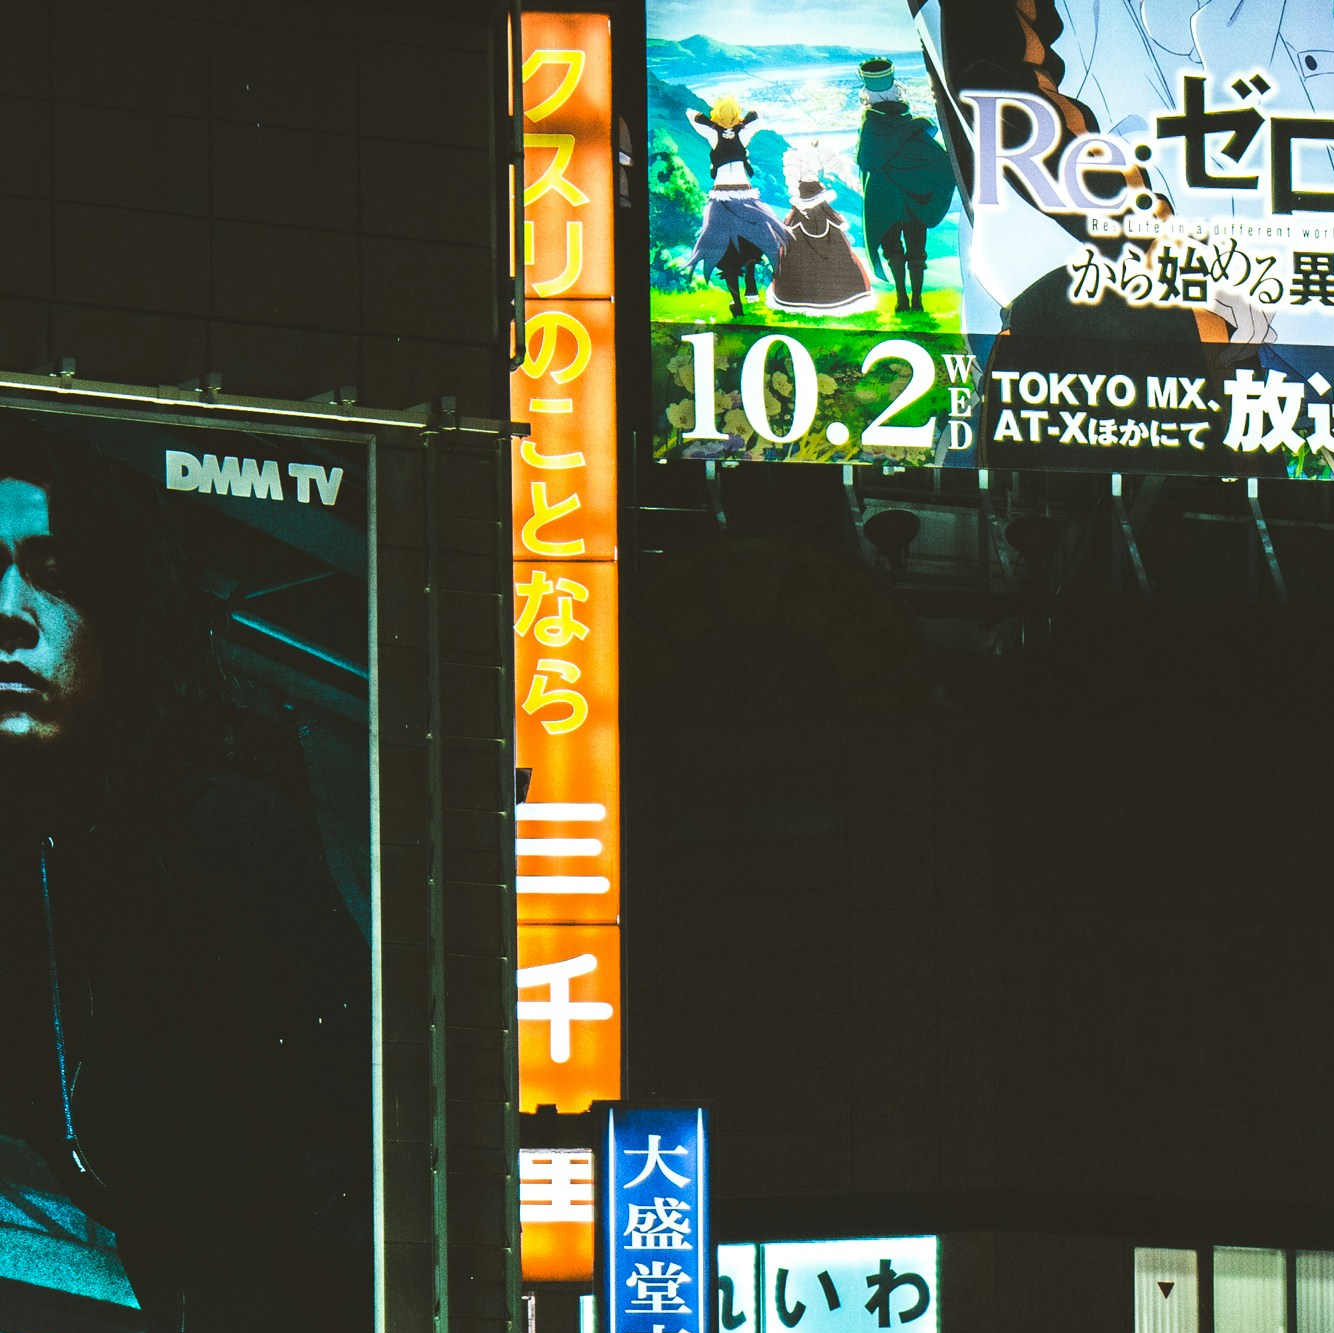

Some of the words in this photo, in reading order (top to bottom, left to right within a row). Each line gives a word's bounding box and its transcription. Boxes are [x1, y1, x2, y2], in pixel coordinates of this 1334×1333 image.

[1127, 219, 1161, 234] Life
[514, 49, 592, 737] クスリのことなら
[680, 332, 937, 449] 10.2
[941, 353, 977, 451] WED
[991, 371, 1136, 407] TOKYO
[991, 410, 1212, 450] AT-Xほかにて
[165, 449, 284, 501] DMM
[288, 462, 344, 506] TV
